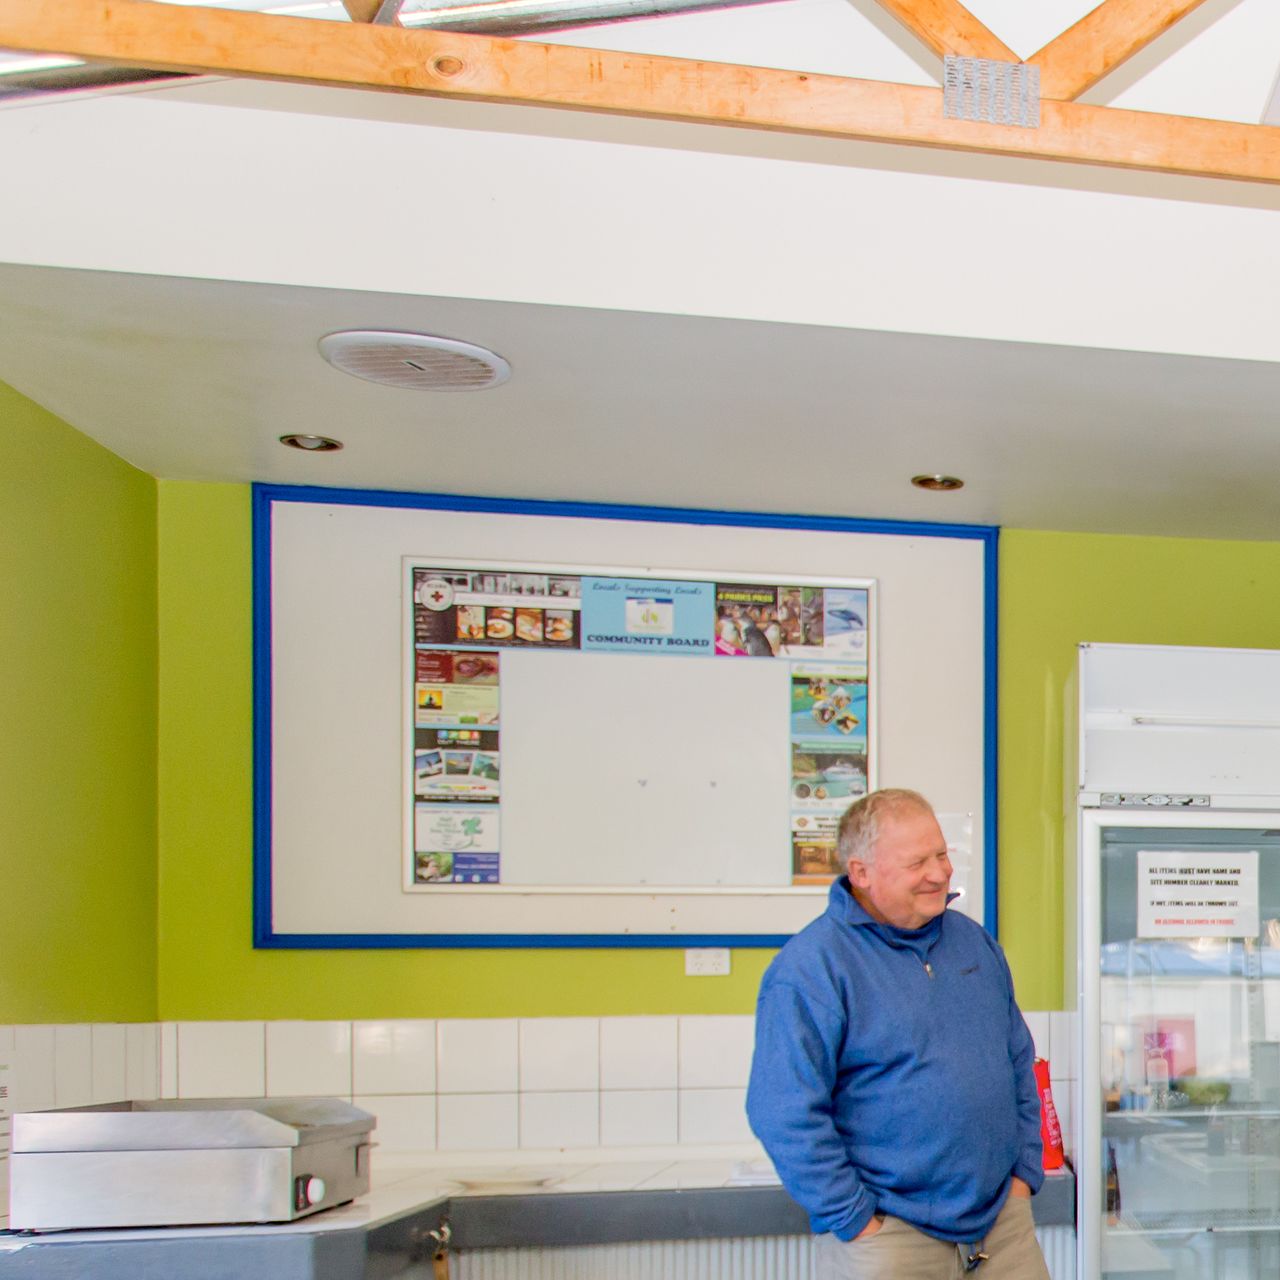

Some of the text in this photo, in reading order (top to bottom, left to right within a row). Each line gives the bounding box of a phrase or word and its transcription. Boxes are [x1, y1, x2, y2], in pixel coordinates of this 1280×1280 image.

[625, 583, 672, 595] Supporting
[587, 634, 664, 645] COMMUNITY
[667, 637, 710, 647] BOARD
